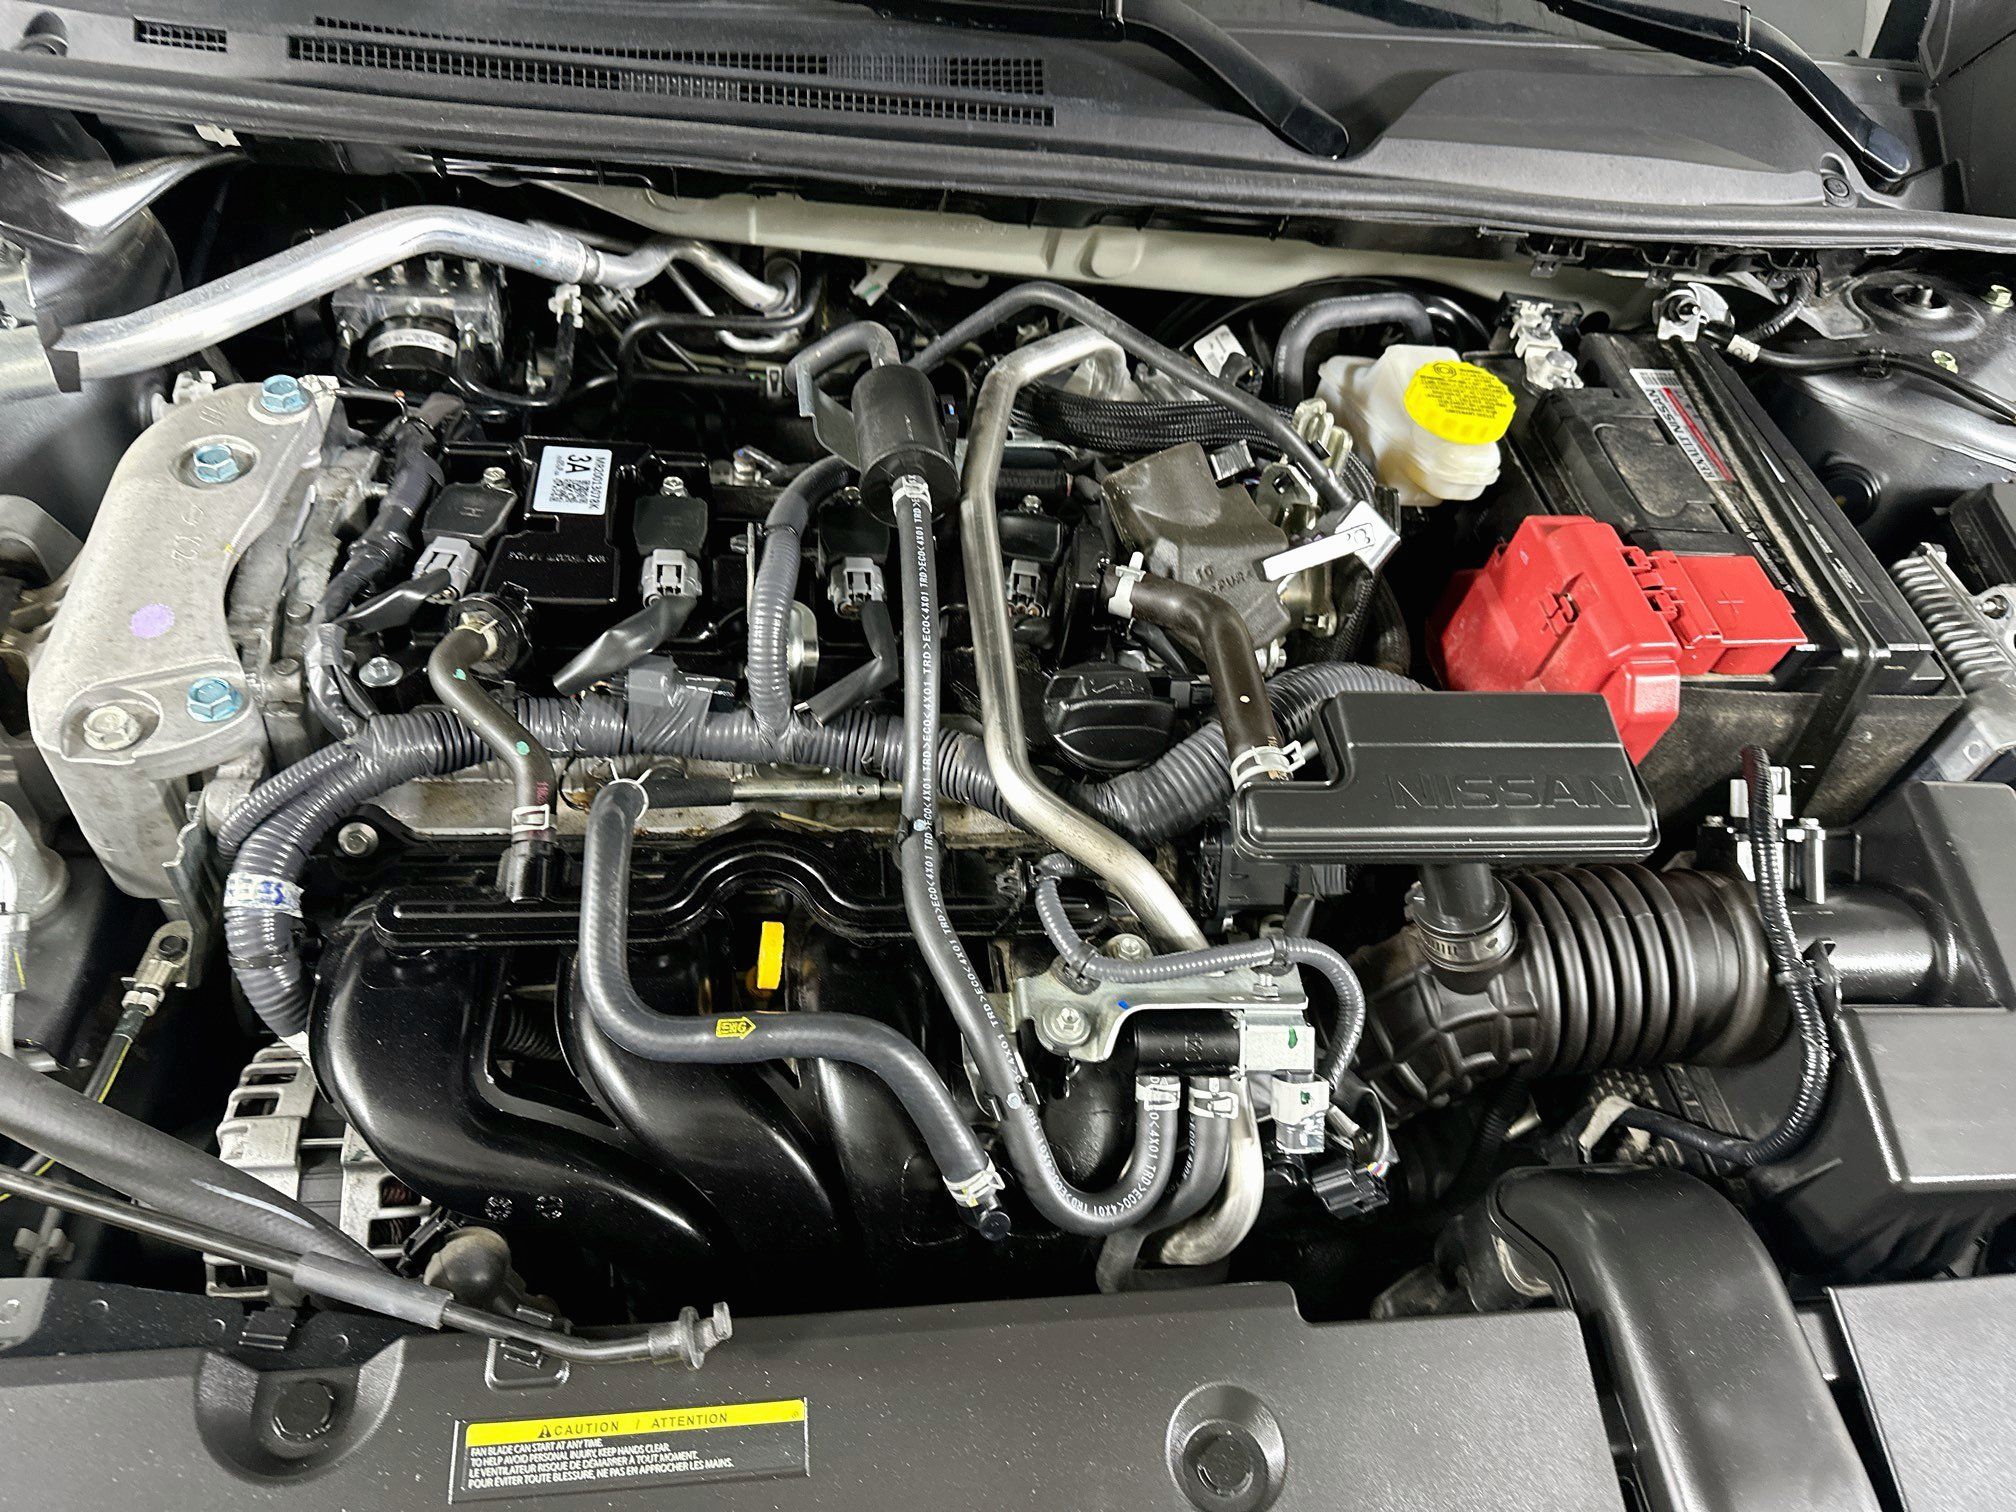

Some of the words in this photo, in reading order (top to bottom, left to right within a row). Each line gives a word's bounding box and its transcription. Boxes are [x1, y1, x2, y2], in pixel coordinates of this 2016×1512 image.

[1645, 388, 1684, 434] NISSAN
[565, 454, 592, 474] 3A
[1678, 435, 1716, 478] RENAULT
[1386, 774, 1631, 809] NISSAN
[721, 1021, 747, 1035] ENG
[554, 1420, 619, 1437] CAUTION
[651, 1412, 728, 1429] ATTENTION
[470, 1457, 483, 1467] TO
[483, 1455, 504, 1466] HELP
[503, 1454, 529, 1465] AVOID
[529, 1451, 570, 1463] PERSONAL
[598, 1446, 617, 1457] KEEP
[617, 1444, 645, 1456] HANDS
[471, 1446, 487, 1457] FAN
[487, 1444, 514, 1456] BLADE
[514, 1443, 532, 1454] CAN
[532, 1441, 556, 1452] START
[556, 1440, 567, 1450] AT
[566, 1439, 583, 1450] ANY
[583, 1438, 604, 1448] TIME.
[468, 1478, 494, 1489] POUR
[523, 1472, 552, 1484] TOUTE
[552, 1468, 596, 1482] BLESSURE,
[596, 1467, 609, 1478] NE
[609, 1466, 625, 1477] PAS
[626, 1465, 639, 1476] EN
[638, 1460, 689, 1475] APPROCHER
[689, 1459, 705, 1471] LES
[704, 1457, 735, 1469] MAINS.
[469, 1468, 480, 1478] LE
[480, 1464, 537, 1477] VENTILATEUR
[537, 1461, 569, 1473] RISQUE
[568, 1460, 581, 1470] DE
[582, 1456, 628, 1469] DÉMARRER
[635, 1453, 661, 1464] TOUT
[660, 1450, 700, 1462] MOMENT.
